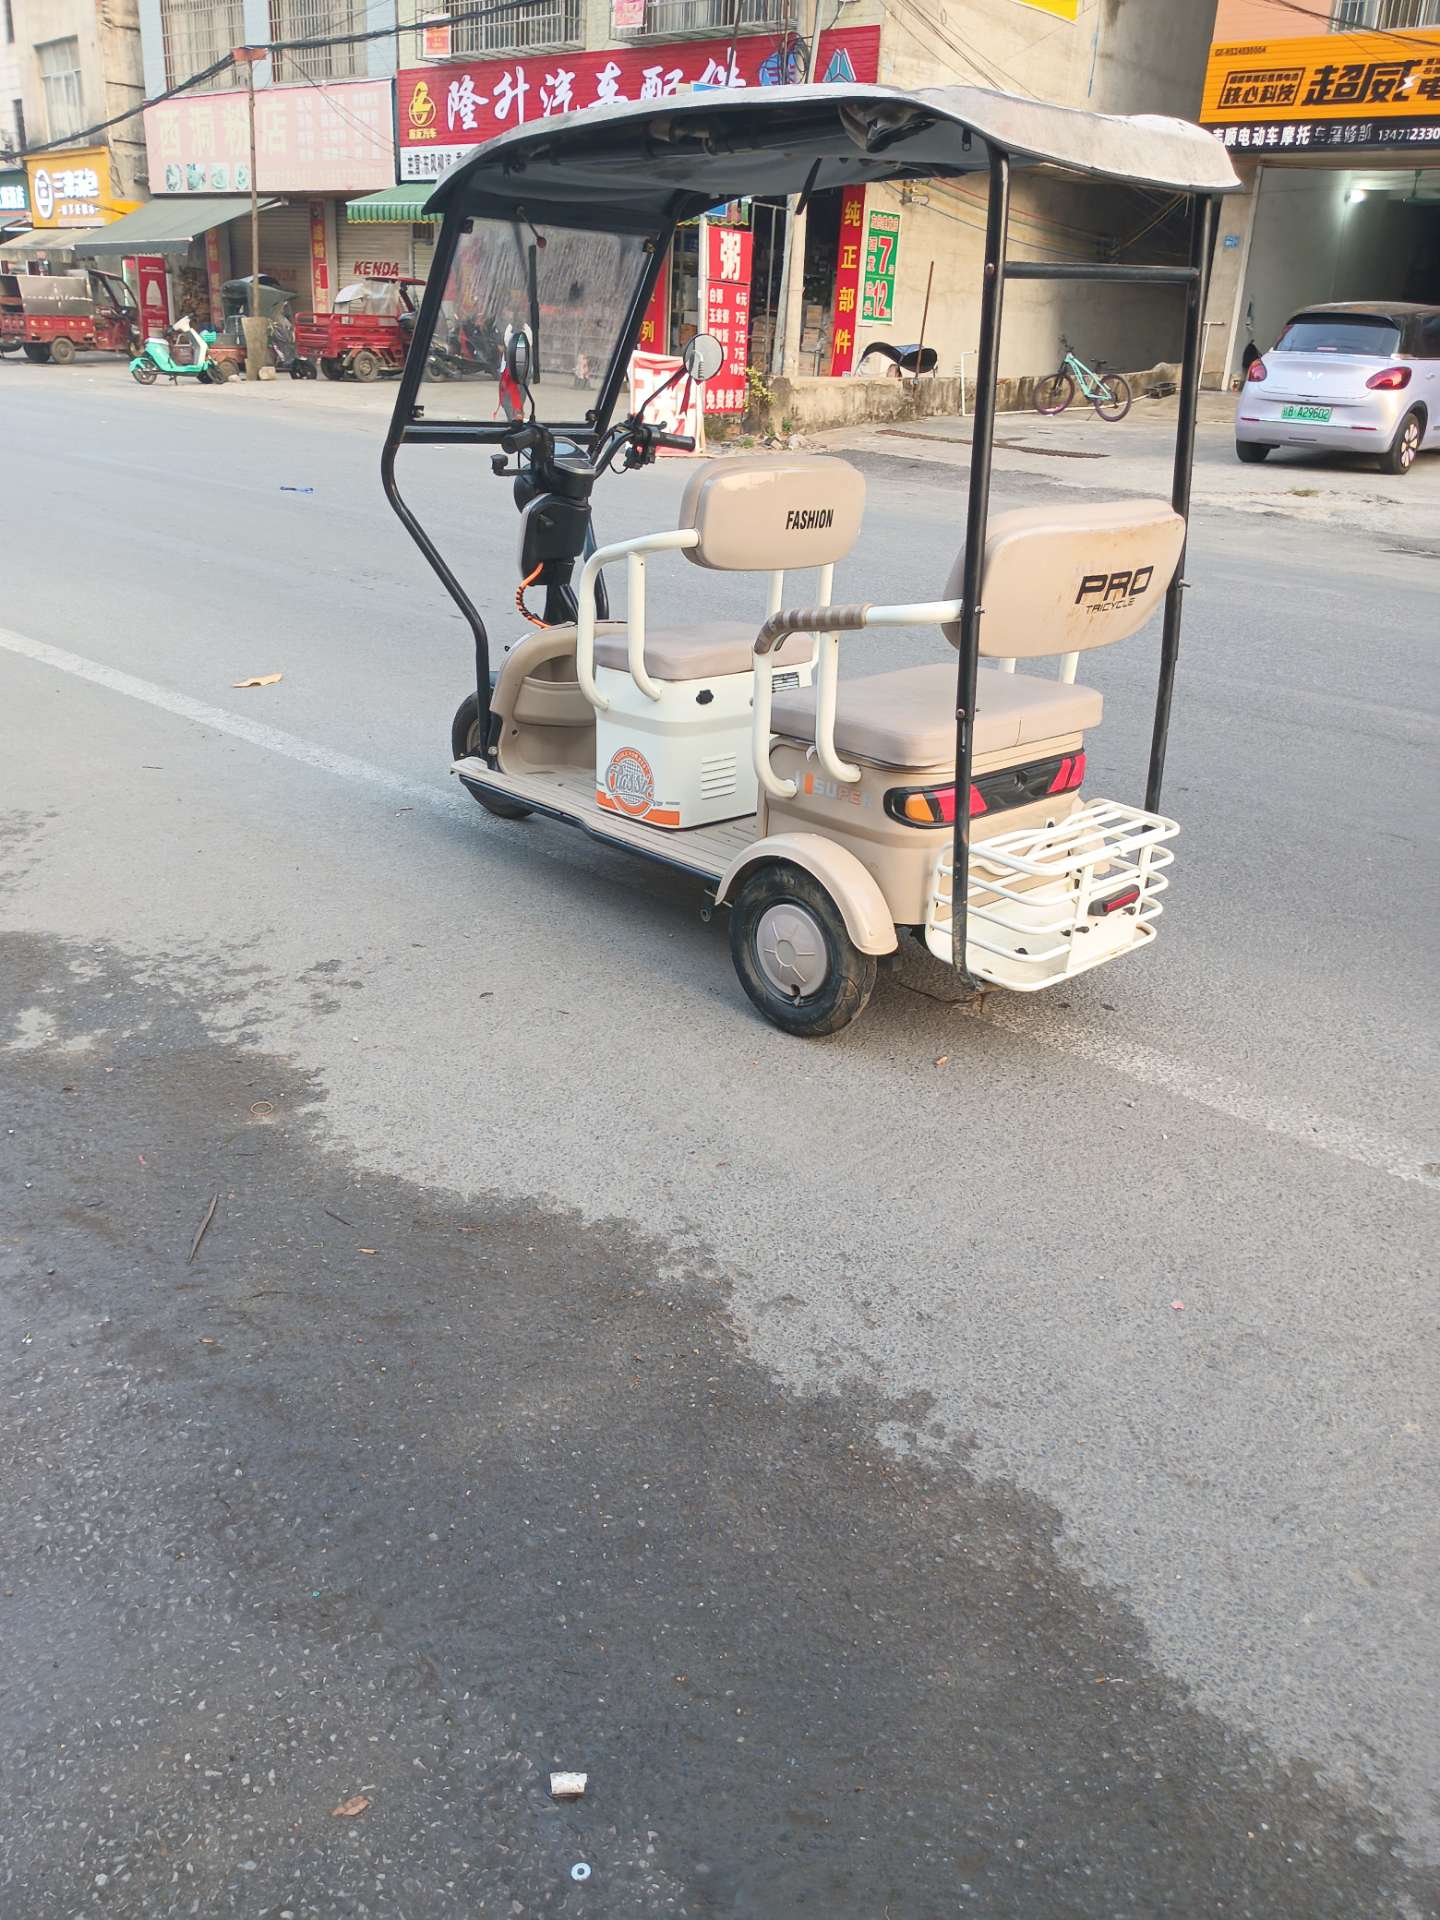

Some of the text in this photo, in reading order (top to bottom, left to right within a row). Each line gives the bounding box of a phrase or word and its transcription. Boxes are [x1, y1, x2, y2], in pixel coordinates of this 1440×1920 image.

[720, 230, 741, 280] 粥
[353, 261, 399, 276] KENDA
[834, 200, 862, 355] 纯正部件
[640, 320, 655, 342] 列
[785, 509, 834, 530] FASHION
[1075, 565, 1154, 605] PRO
[1086, 597, 1136, 614] TRICYCLE
